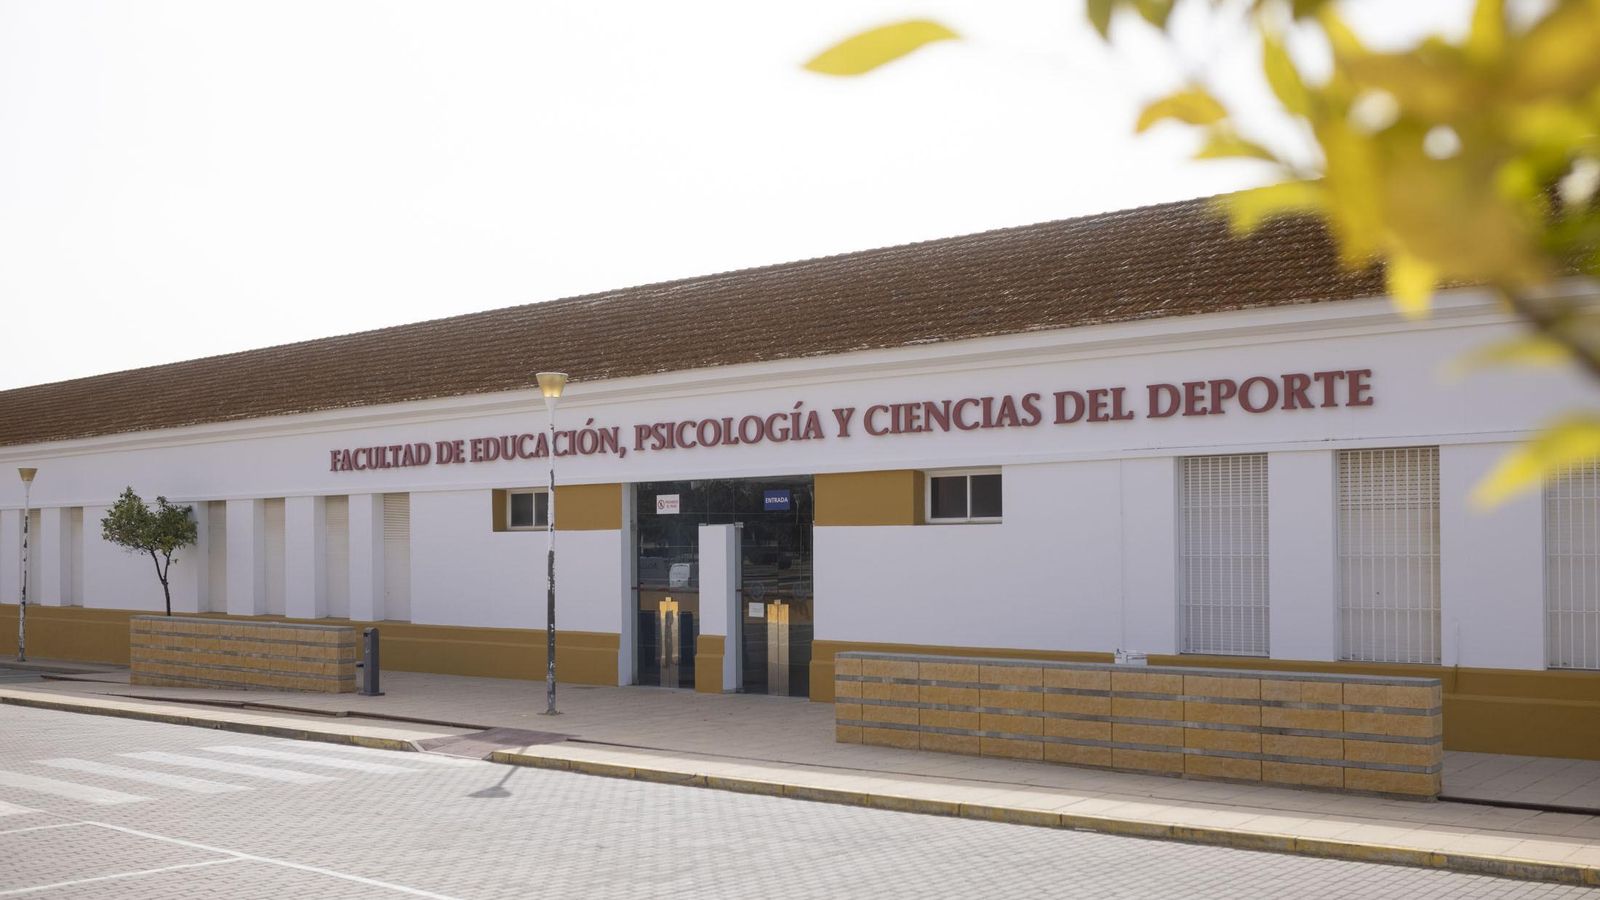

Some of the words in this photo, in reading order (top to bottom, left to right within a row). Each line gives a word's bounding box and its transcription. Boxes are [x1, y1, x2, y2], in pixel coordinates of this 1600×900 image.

[330, 443, 432, 472] FACULTAD
[436, 440, 465, 465] DE
[470, 418, 626, 464] EDUCACIÓN,
[634, 400, 824, 452] PSICOLOGÍA
[833, 407, 855, 438] Y
[864, 393, 1042, 437] CIENCIAS
[1053, 387, 1134, 424] DEL
[1147, 369, 1375, 419] DEPORTE
